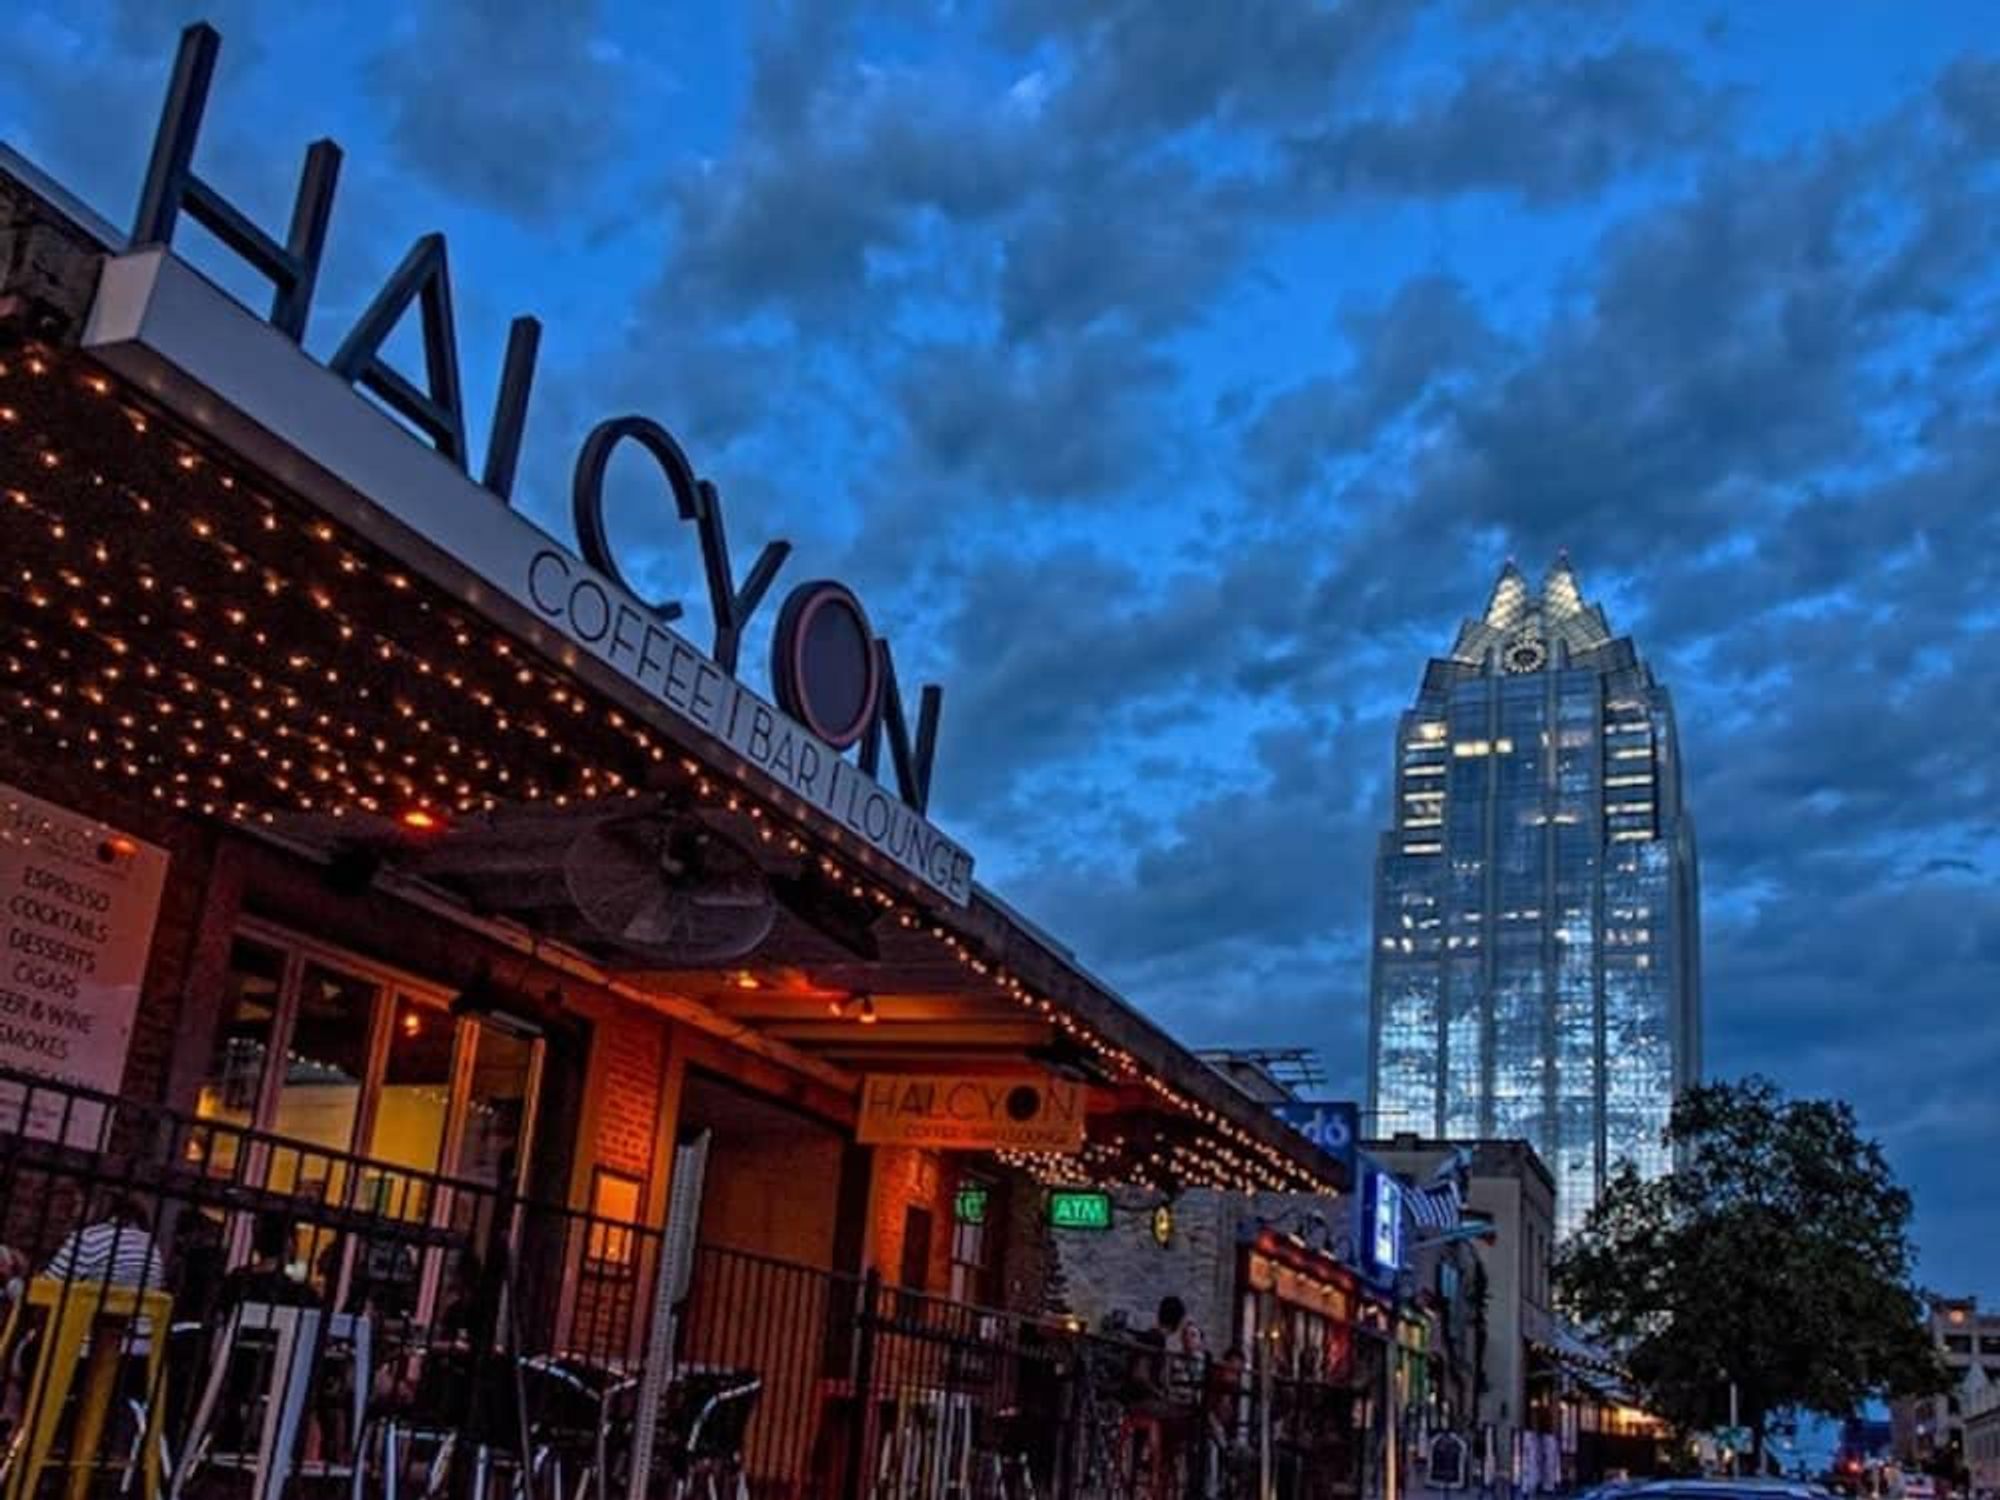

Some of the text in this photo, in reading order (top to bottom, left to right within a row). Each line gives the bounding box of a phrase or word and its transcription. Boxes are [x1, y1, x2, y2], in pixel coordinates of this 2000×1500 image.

[131, 20, 941, 816] HALCYON
[528, 550, 720, 726] COFFEE
[748, 706, 820, 797] BAR
[847, 779, 969, 900] LOUNGE
[24, 866, 110, 913] ESPRESSO
[9, 896, 110, 944] COCKTAILS
[9, 927, 96, 974] DESSERTS
[13, 961, 79, 999] CIGARS
[48, 1004, 95, 1036] WINE
[866, 1079, 1077, 1123] HALCYON
